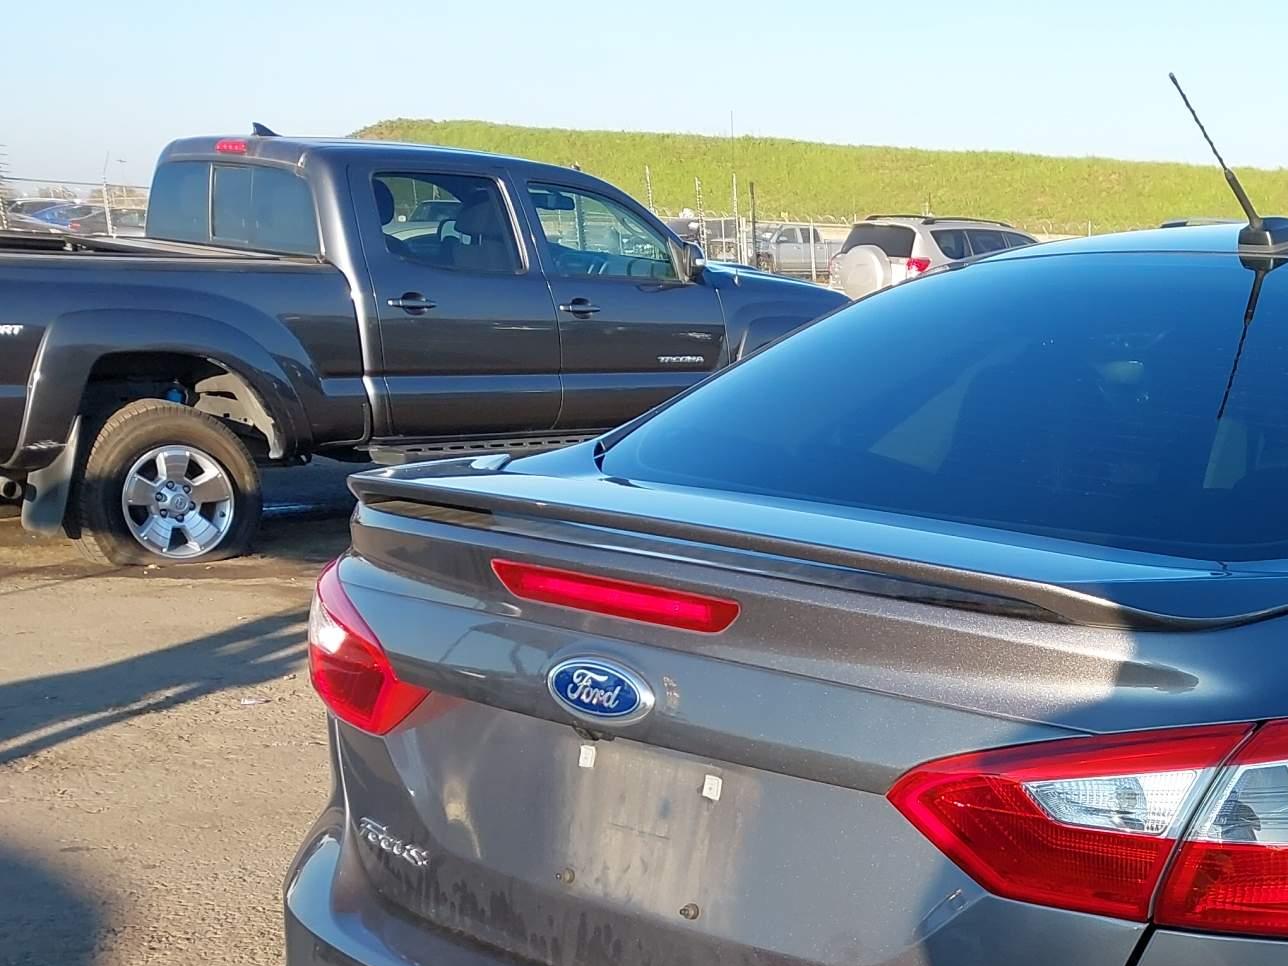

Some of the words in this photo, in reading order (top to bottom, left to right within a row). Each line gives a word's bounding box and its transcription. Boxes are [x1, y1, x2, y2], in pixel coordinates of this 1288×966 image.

[0, 324, 24, 336] RT
[656, 355, 705, 363] TACOMA
[566, 669, 622, 709] Ford
